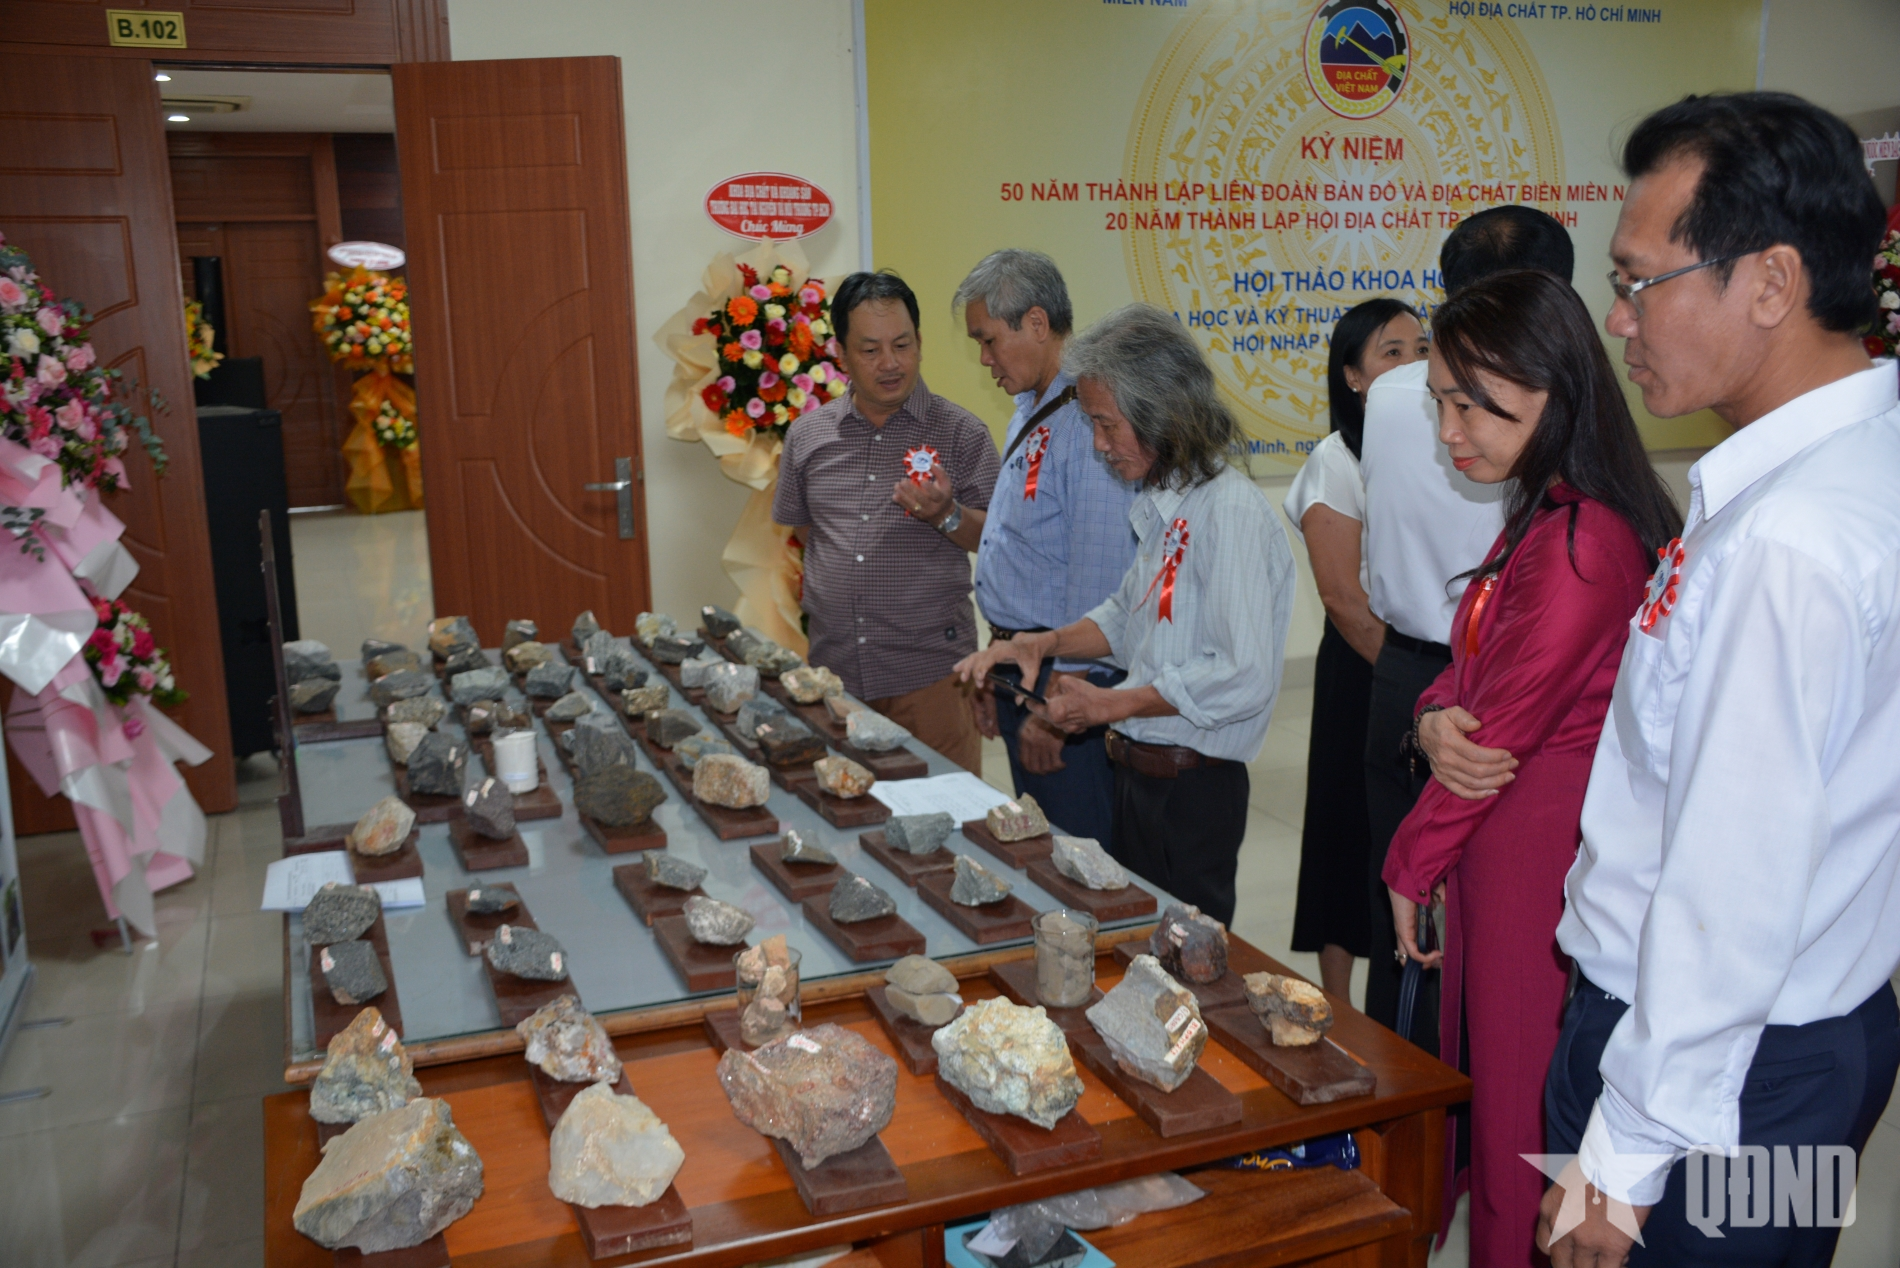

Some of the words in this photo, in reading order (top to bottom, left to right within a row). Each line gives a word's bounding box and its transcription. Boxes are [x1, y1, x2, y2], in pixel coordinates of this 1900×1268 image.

[1449, 0, 1475, 19] HỘI
[1479, 2, 1503, 20] ĐỊA
[1508, 1, 1546, 19] CHẤT
[1551, 5, 1572, 20] TP.
[1576, 4, 1596, 21] HỒ
[1600, 5, 1624, 22] CHÍ
[1627, 8, 1661, 23] MINH
[117, 18, 178, 40] B.102
[1336, 71, 1352, 81] ĐỊA
[1354, 68, 1378, 81] CHẤT
[1335, 82, 1356, 94] VIỆT
[1358, 84, 1379, 94] NAM
[1301, 130, 1335, 159] KỶ
[1343, 135, 1403, 166] NIỆM
[1000, 183, 1023, 201] 50
[1031, 178, 1078, 201] NĂM
[1085, 178, 1157, 201] THÀNH
[1165, 180, 1204, 205] LẬP
[1211, 179, 1254, 201] LIÊN
[1261, 179, 1317, 201] ĐOÀN
[1324, 179, 1363, 201] BẢN
[1369, 180, 1396, 201] ĐỒ
[1402, 180, 1426, 201] VÀ
[1432, 184, 1462, 205] ĐỊA
[1468, 180, 1516, 201] CHẤT
[1522, 180, 1561, 201] BIỂN
[1567, 180, 1607, 201] MIỀN
[740, 219, 769, 233] Chúc
[770, 220, 804, 237] Mừng
[1105, 212, 1127, 230] 20
[1135, 208, 1180, 230] NĂM
[1187, 208, 1255, 230] THÀNH
[1263, 210, 1300, 233] LẬP
[1306, 210, 1338, 233] HỘI
[1344, 212, 1376, 233] ĐỊA
[1382, 208, 1432, 229] CHẤT
[1234, 269, 1274, 300] HỘI
[1284, 265, 1345, 291] THẢO
[1352, 269, 1415, 290] KHOA
[1189, 309, 1228, 330] HỌC
[1235, 306, 1259, 325] VÀ
[1265, 305, 1289, 325] KỸ
[1233, 334, 1264, 356] HỘI
[1271, 332, 1320, 354] NHẬP
